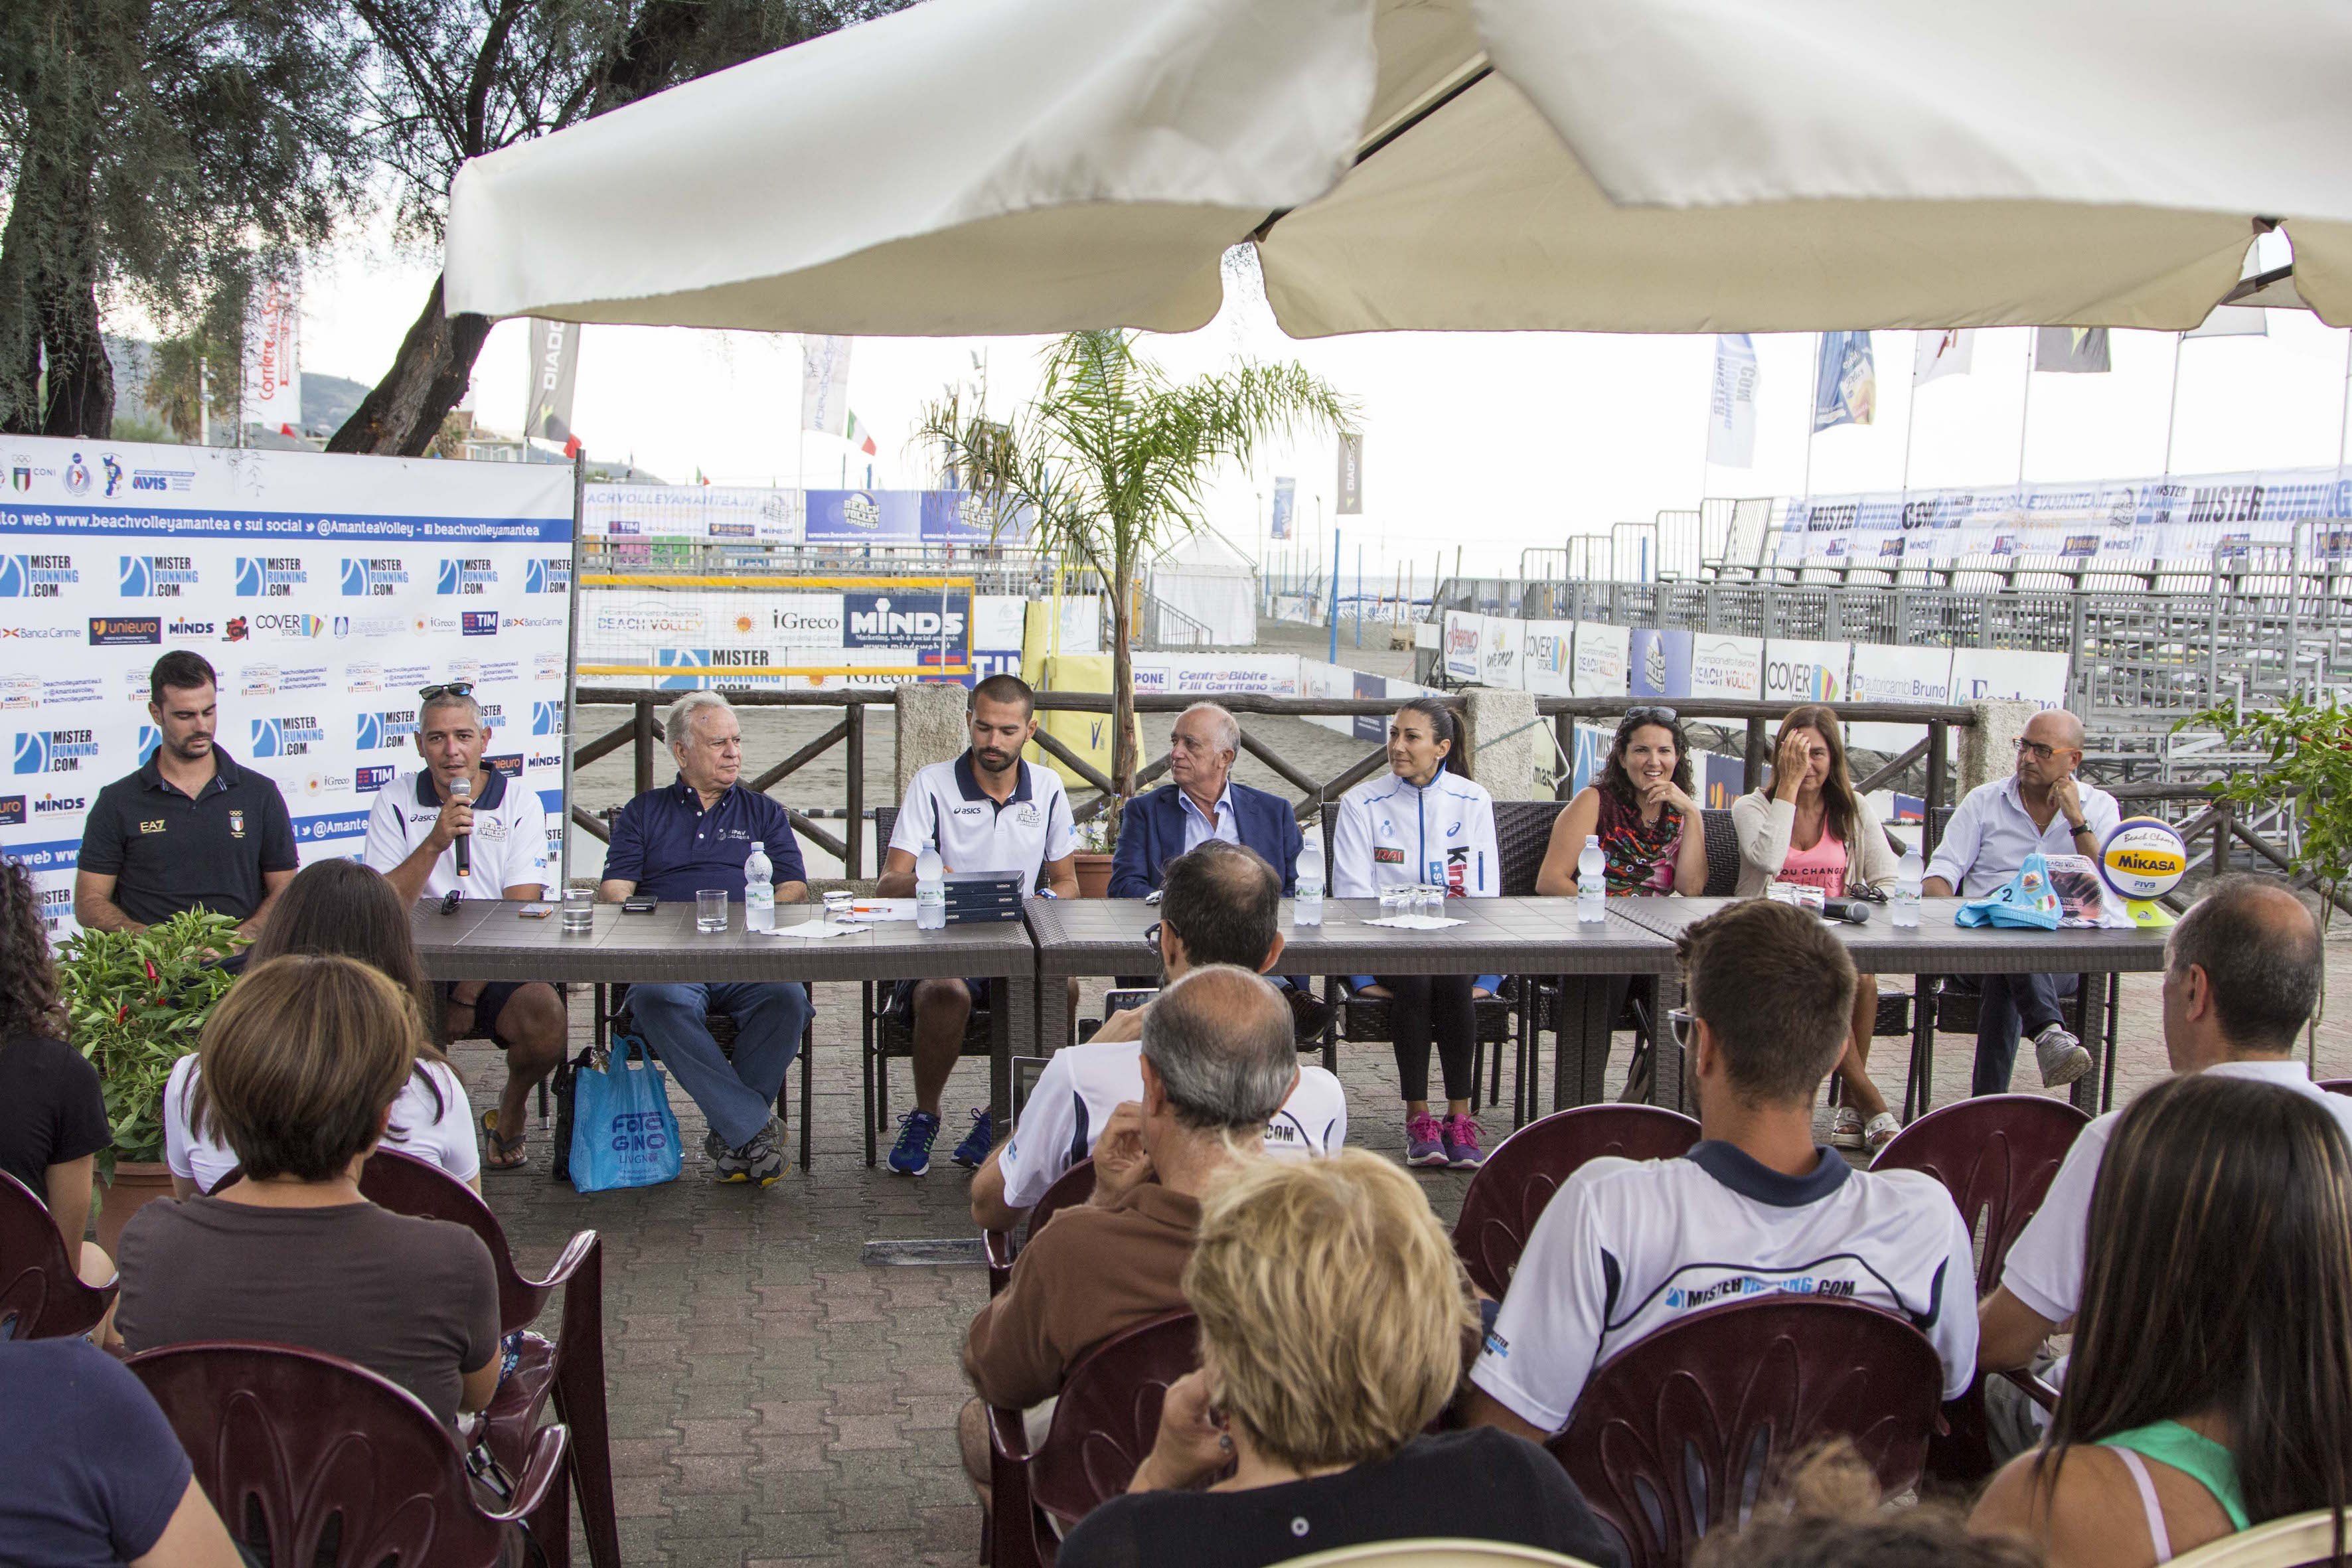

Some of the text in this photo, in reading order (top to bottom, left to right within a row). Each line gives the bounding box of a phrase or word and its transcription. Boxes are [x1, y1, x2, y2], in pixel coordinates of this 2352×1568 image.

[133, 477, 167, 491] AVIS
[844, 499, 880, 514] BEACH
[2188, 485, 2265, 523] MISTER
[22, 512, 52, 526] web
[55, 514, 230, 532] www.beachvolleyamantea
[234, 520, 242, 530] e
[245, 518, 263, 531] sui
[266, 519, 302, 532] social
[317, 519, 414, 537] @AmanteaVolley
[434, 522, 540, 538] beachvolleyamantea
[31, 556, 70, 568] MISTER
[155, 557, 191, 569] MISTER
[268, 558, 300, 570] MISTER
[371, 560, 402, 570] MISTER
[465, 560, 491, 570] MISTER
[31, 570, 78, 582] RUNNING
[155, 571, 198, 583] RUNNING
[268, 572, 307, 583] RUNNING
[371, 572, 409, 583] RUNNING
[463, 571, 498, 582] RUNNING
[256, 615, 301, 629] COVER
[477, 614, 497, 627] TIM
[773, 609, 839, 629] iGreco
[851, 597, 964, 635] MINDS
[108, 620, 157, 633] unieuro
[169, 617, 214, 634] MINDS
[597, 617, 704, 631] BEACH VOLLEY
[21, 627, 81, 639] Banca Carime
[1526, 636, 1552, 658] COVER
[712, 649, 769, 665] MISTER
[1768, 661, 1810, 692] COVER
[1212, 682, 1268, 691] Garritano
[283, 717, 317, 730] MISTER
[386, 711, 415, 724] MISTER
[284, 729, 324, 743] RUNNING
[384, 722, 420, 736] RUNNING
[53, 730, 92, 744] MISTER
[52, 743, 98, 758] RUNNING
[528, 752, 561, 767] MINDS
[371, 768, 393, 782] TIM
[35, 793, 85, 812] MINDS
[139, 819, 166, 832] EA7
[2124, 832, 2176, 847] Beach Champ
[22, 850, 52, 865] web
[2118, 853, 2176, 871] MIKASA
[1802, 867, 1843, 876] CHANGE
[2001, 889, 2013, 902] 2
[612, 1133, 666, 1152] GINO
